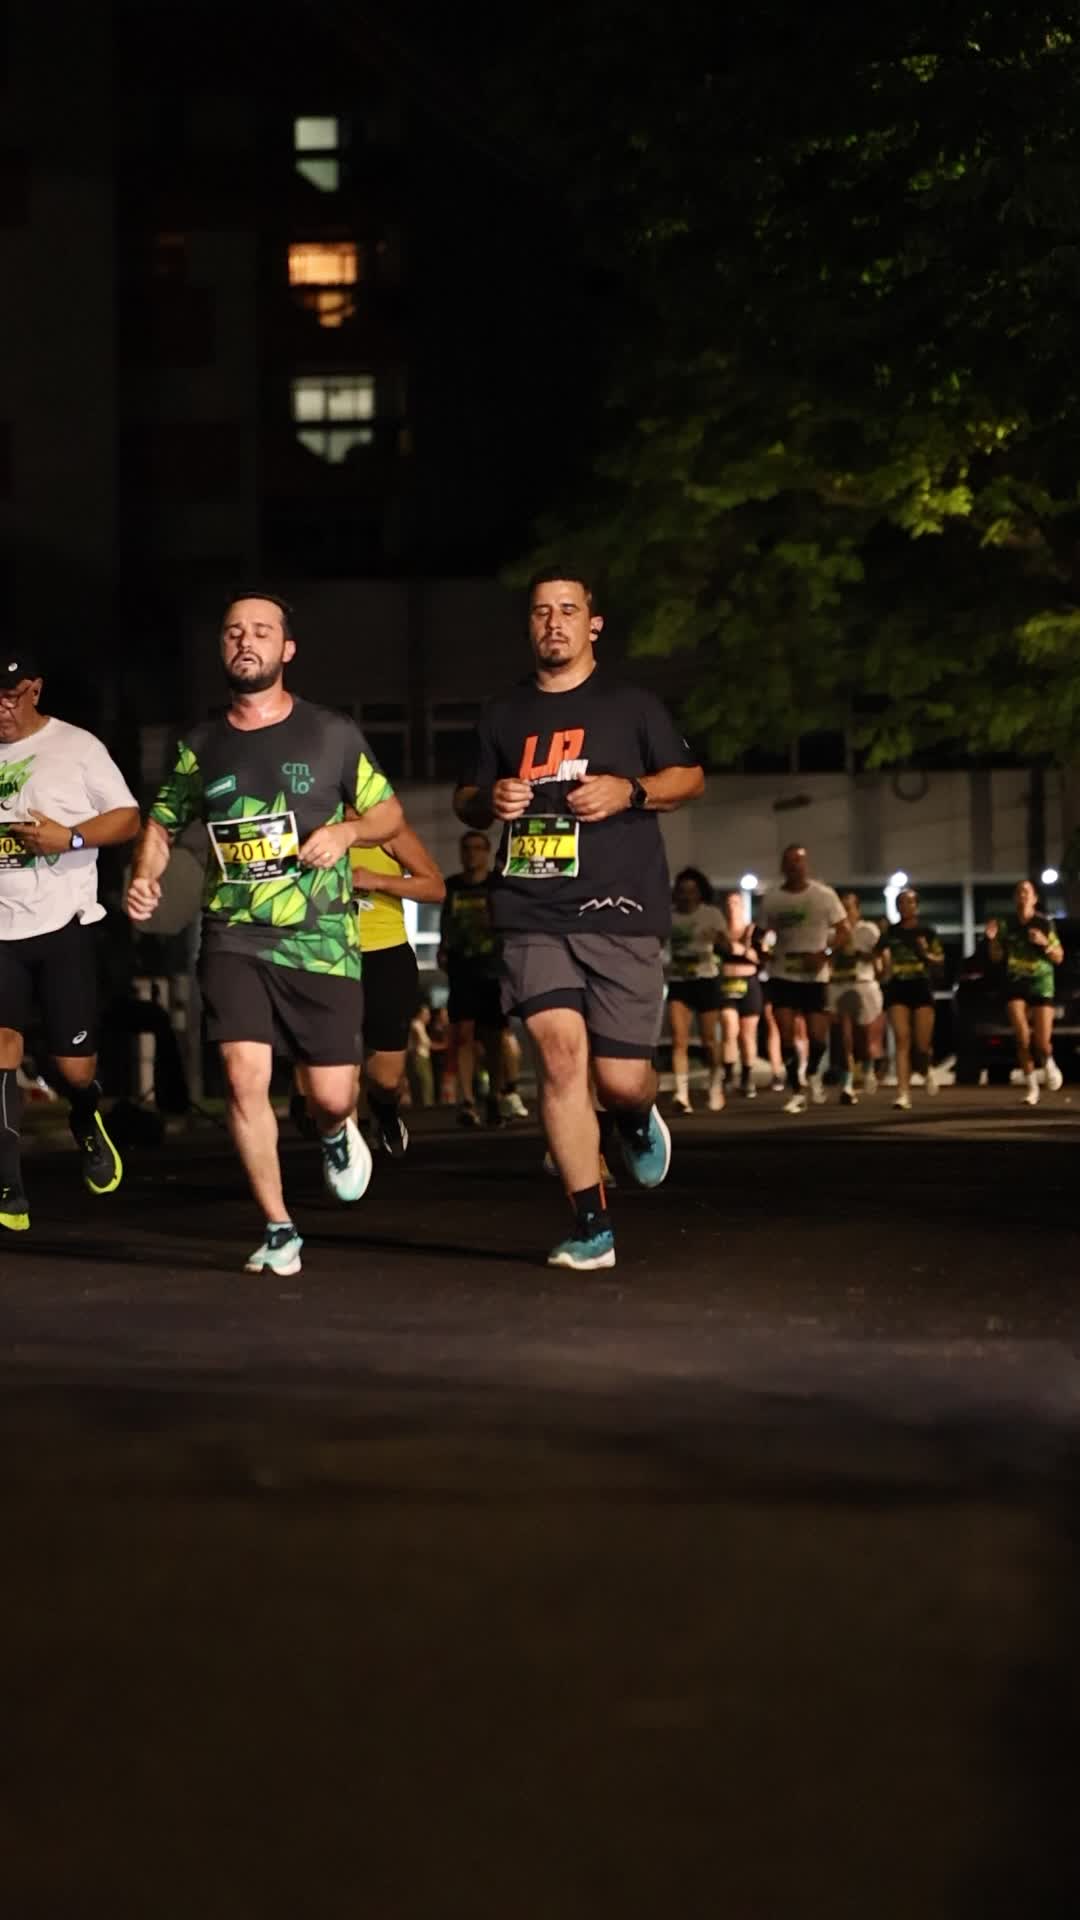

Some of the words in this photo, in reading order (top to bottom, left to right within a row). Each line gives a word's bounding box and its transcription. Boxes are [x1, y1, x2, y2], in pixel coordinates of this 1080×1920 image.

[520, 728, 584, 780] UP
[282, 763, 309, 776] cm
[518, 838, 560, 857] 2377
